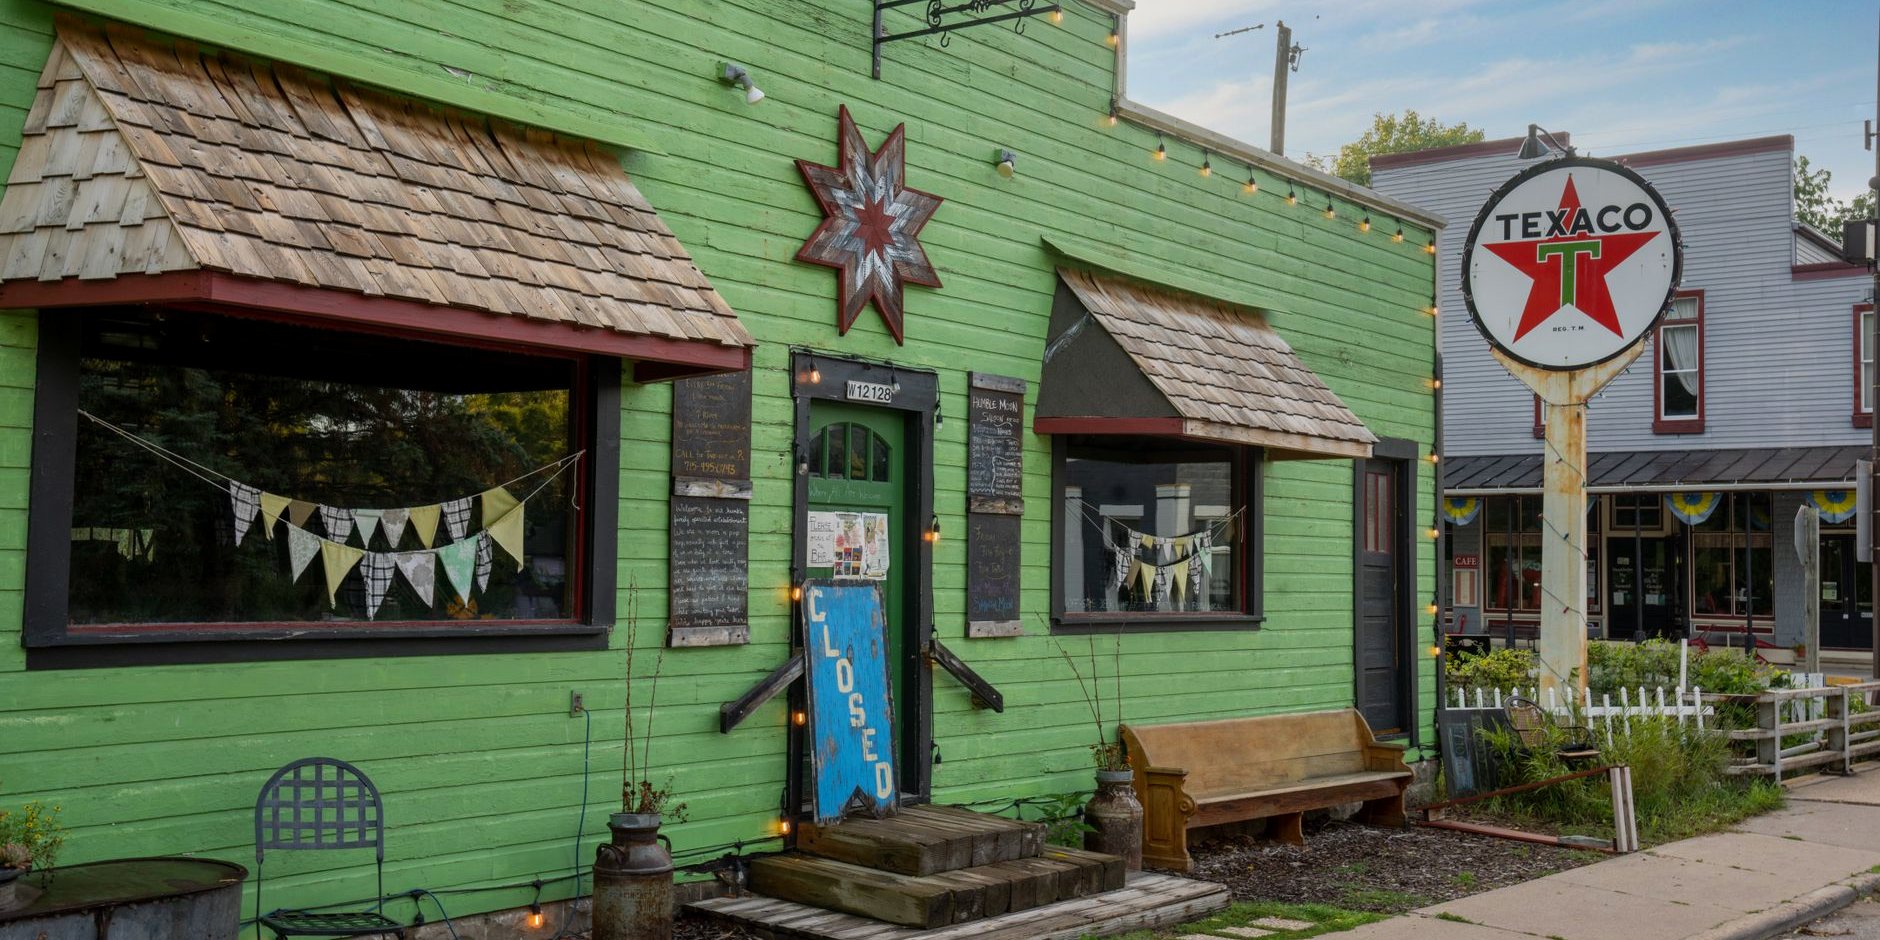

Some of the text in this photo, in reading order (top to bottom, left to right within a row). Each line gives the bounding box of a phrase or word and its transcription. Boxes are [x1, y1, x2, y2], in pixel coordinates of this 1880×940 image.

[1496, 202, 1653, 240] TEXACO
[1538, 239, 1601, 308] T
[848, 383, 891, 402] W12128
[972, 396, 1018, 413] HUMBLE MOON
[1455, 556, 1477, 566] CAFE
[809, 588, 893, 800] CLOSED
